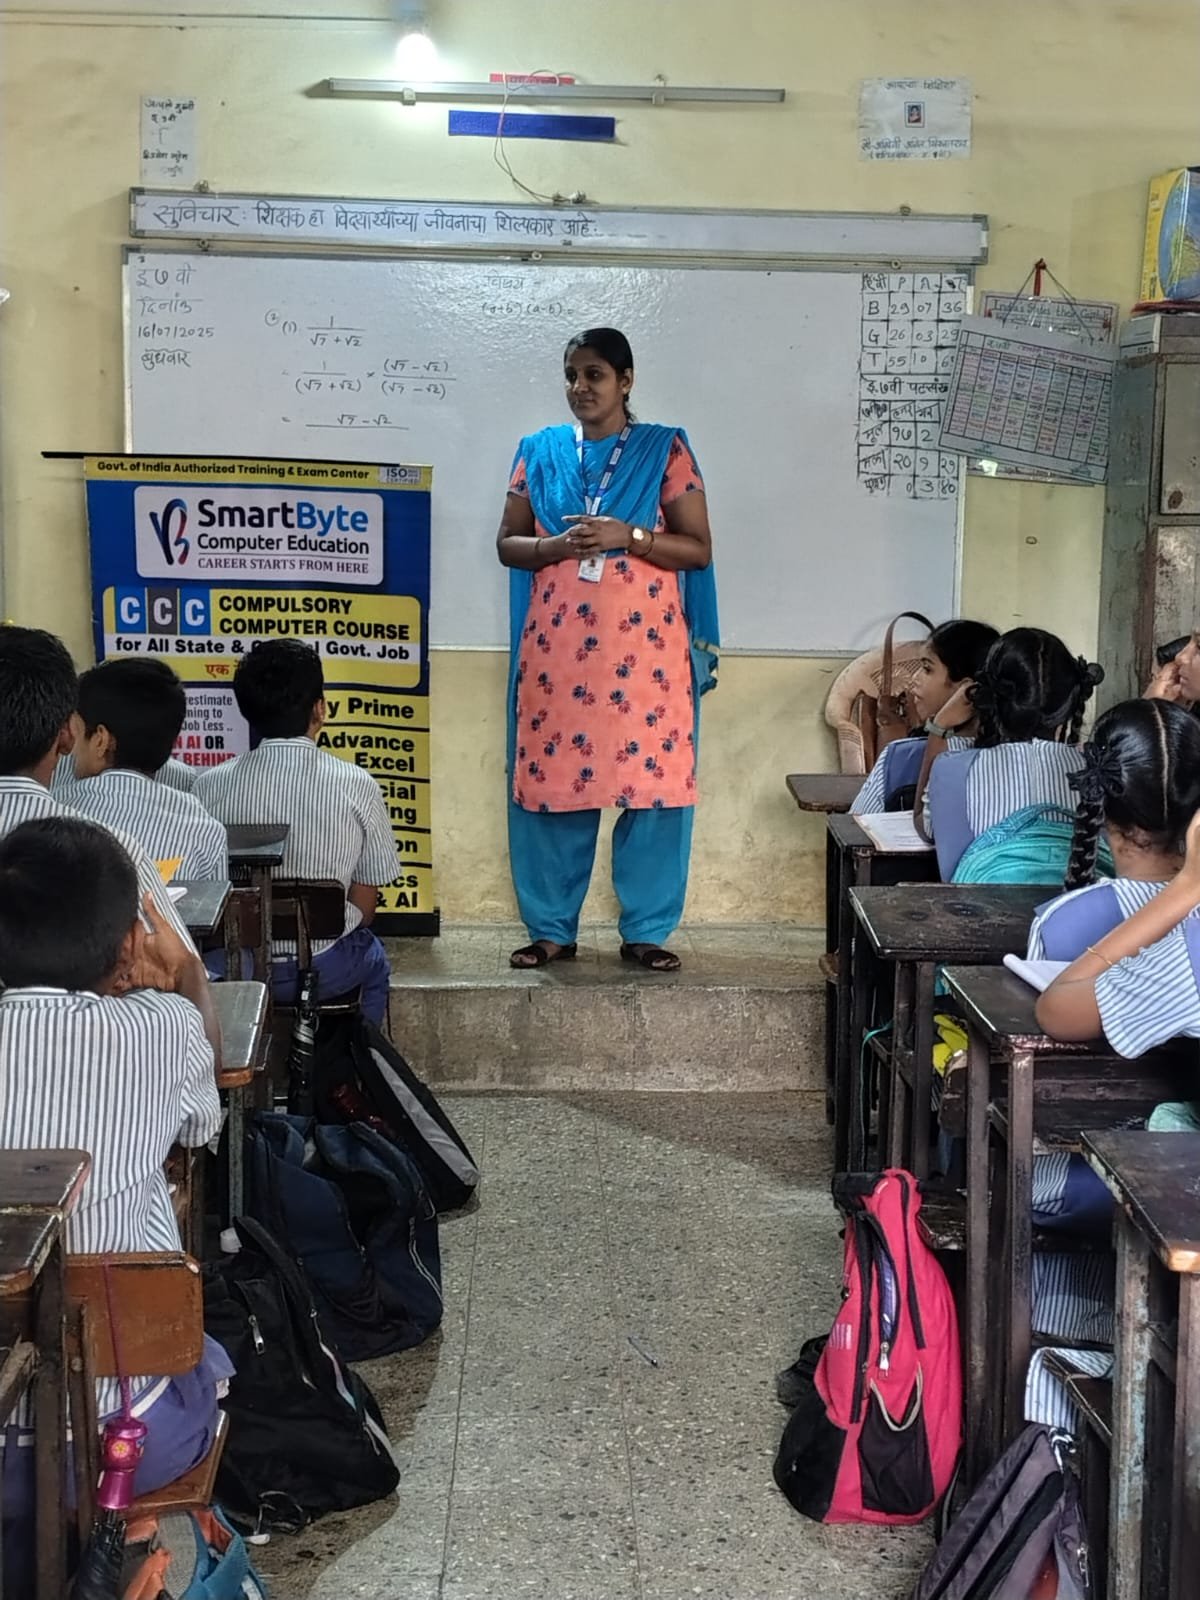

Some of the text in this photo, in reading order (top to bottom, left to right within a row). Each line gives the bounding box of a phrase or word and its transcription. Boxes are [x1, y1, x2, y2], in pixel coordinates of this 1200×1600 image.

[138, 323, 215, 339] 16/07/2025
[97, 461, 370, 479] Govt. of India Authorized Training & Exam Center
[387, 467, 408, 478] ISO
[198, 500, 369, 536] SmartByte
[198, 534, 369, 555] Computer Education
[198, 557, 369, 574] CAREER STARTS FROM HERE
[219, 596, 352, 615] COMPULSORY
[219, 618, 410, 640] COMPUTER COURSE
[116, 637, 141, 651] for
[147, 639, 170, 653] All
[175, 640, 225, 654] State
[231, 640, 244, 653] &
[326, 641, 371, 657] Govt.
[377, 645, 410, 660] Job
[205, 664, 230, 679] एक
[187, 707, 223, 720] ning to
[348, 697, 414, 719] Prime
[182, 720, 200, 731] Job
[203, 720, 224, 731] Less
[186, 735, 201, 749] AI
[205, 735, 225, 750] OR
[316, 732, 415, 753] Advance
[355, 753, 415, 773] Excel
[380, 781, 416, 800] cial
[395, 892, 418, 908] AI
